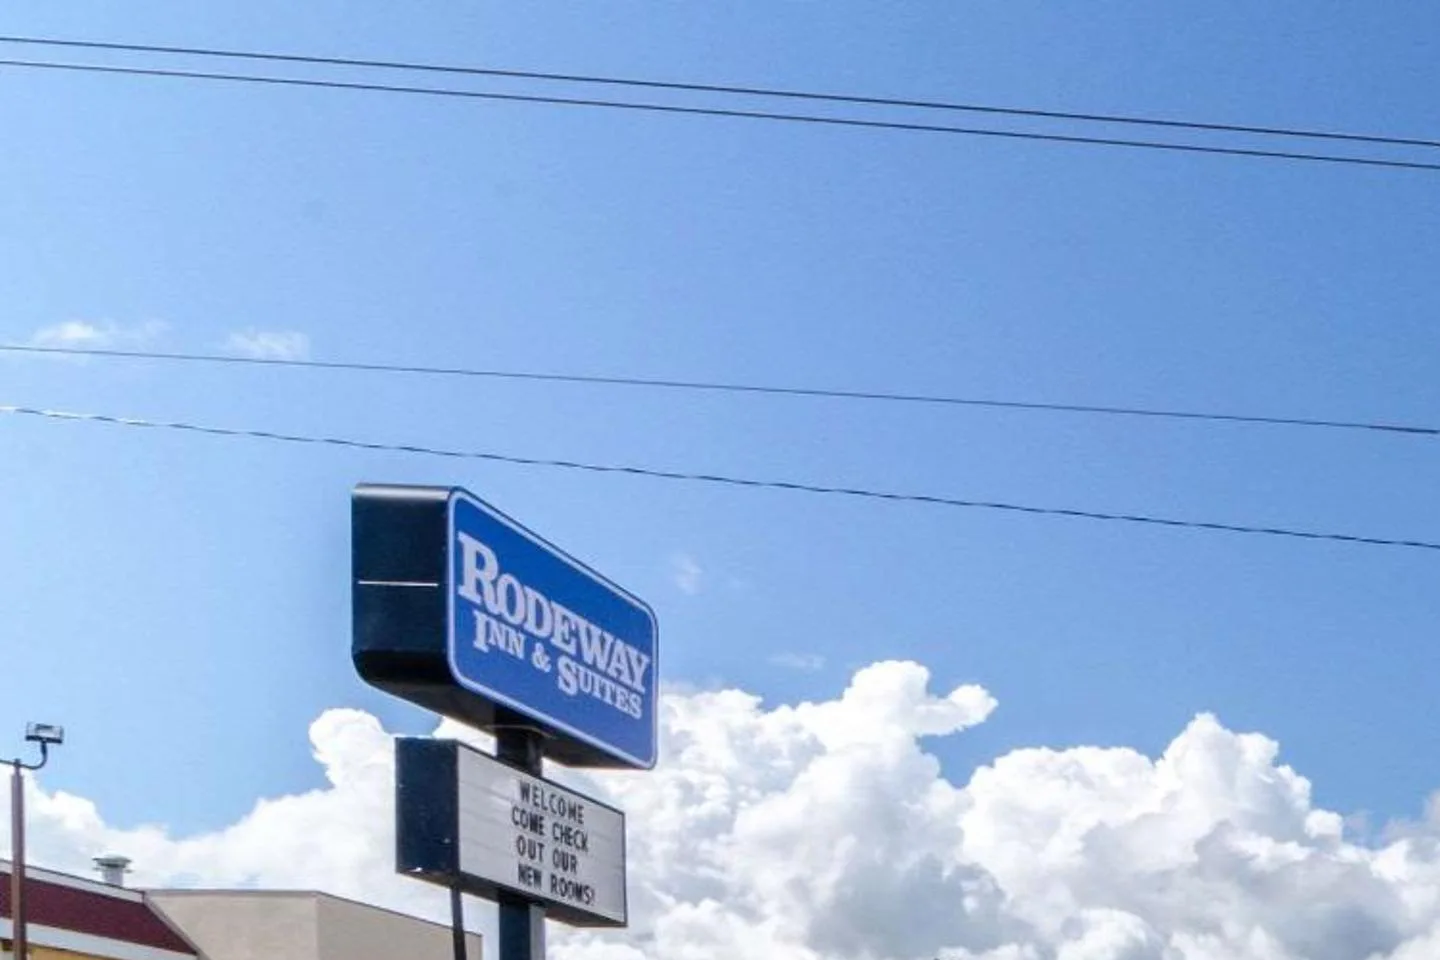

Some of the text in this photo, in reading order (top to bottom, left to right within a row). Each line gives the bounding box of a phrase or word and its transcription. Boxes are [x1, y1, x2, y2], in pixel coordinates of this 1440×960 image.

[458, 531, 650, 692] RODEWAY
[473, 610, 643, 720] INN & SUITES
[519, 779, 585, 825] WELCOME
[511, 806, 590, 853] COME CHECK
[516, 835, 577, 874] OUT OUR
[517, 863, 542, 889] NEW
